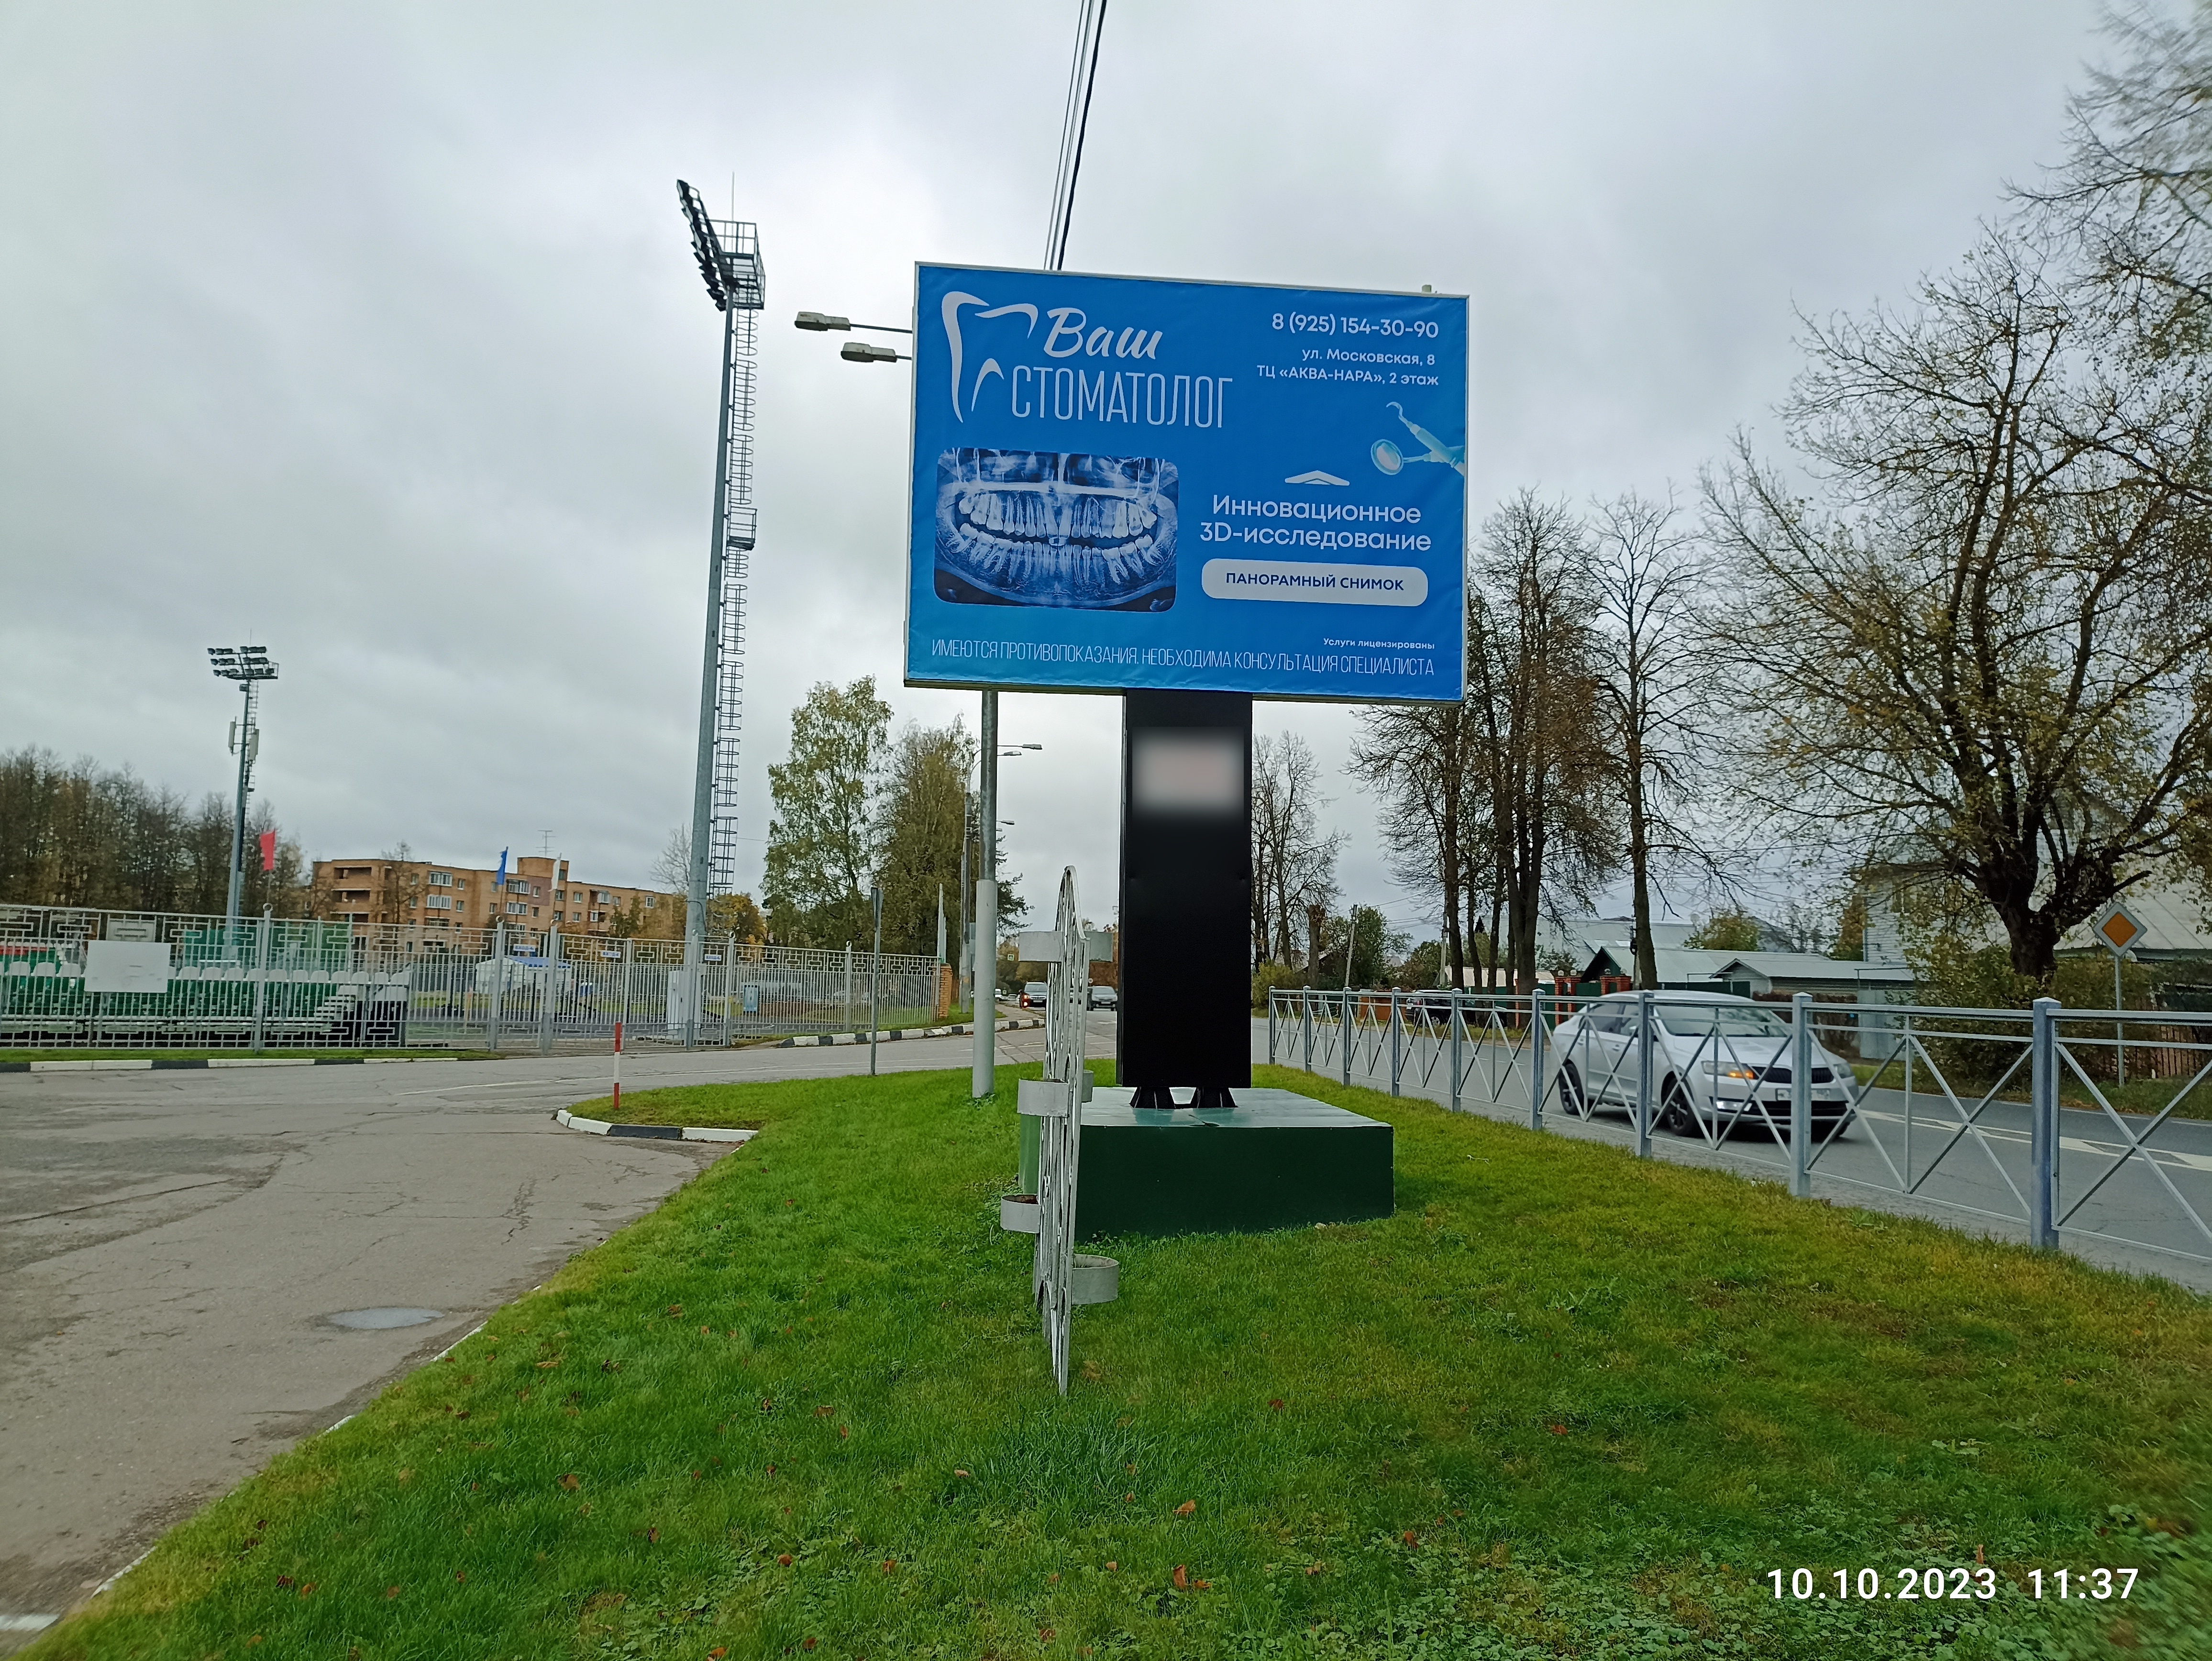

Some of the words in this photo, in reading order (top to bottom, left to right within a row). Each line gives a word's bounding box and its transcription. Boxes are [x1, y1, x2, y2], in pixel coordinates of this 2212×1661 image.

[1043, 307, 1163, 359] Ваш
[1272, 313, 1284, 330] 8
[1289, 311, 1336, 335] (925)
[1341, 317, 1438, 338] 154-30-90
[1302, 350, 1322, 361] ул.
[1327, 348, 1423, 366] Московская,
[1427, 354, 1435, 365] 8
[1257, 365, 1276, 379] ТЦ
[1279, 367, 1385, 384] «АКВА-НАРА»,
[1389, 372, 1397, 384] 2
[1401, 375, 1439, 386] этаж
[1011, 365, 1233, 428] СТОМАТОЛОГ
[1213, 495, 1422, 524] Инновационное
[1200, 521, 1432, 551] 3D-исследование
[1226, 572, 1336, 588] ПАНОРАМНЫЙ
[1340, 577, 1405, 591] СНИМОК
[932, 639, 998, 658] ИМЕЮТСЯ
[1142, 648, 1232, 668] НЕОБХОДИМА
[1234, 652, 1338, 673] КОНСУЛЬТАЦИЯ
[1340, 655, 1435, 675] СПЕЦИАЛИСТА
[1323, 638, 1356, 647] Услуги
[1358, 640, 1435, 650] лицензированы
